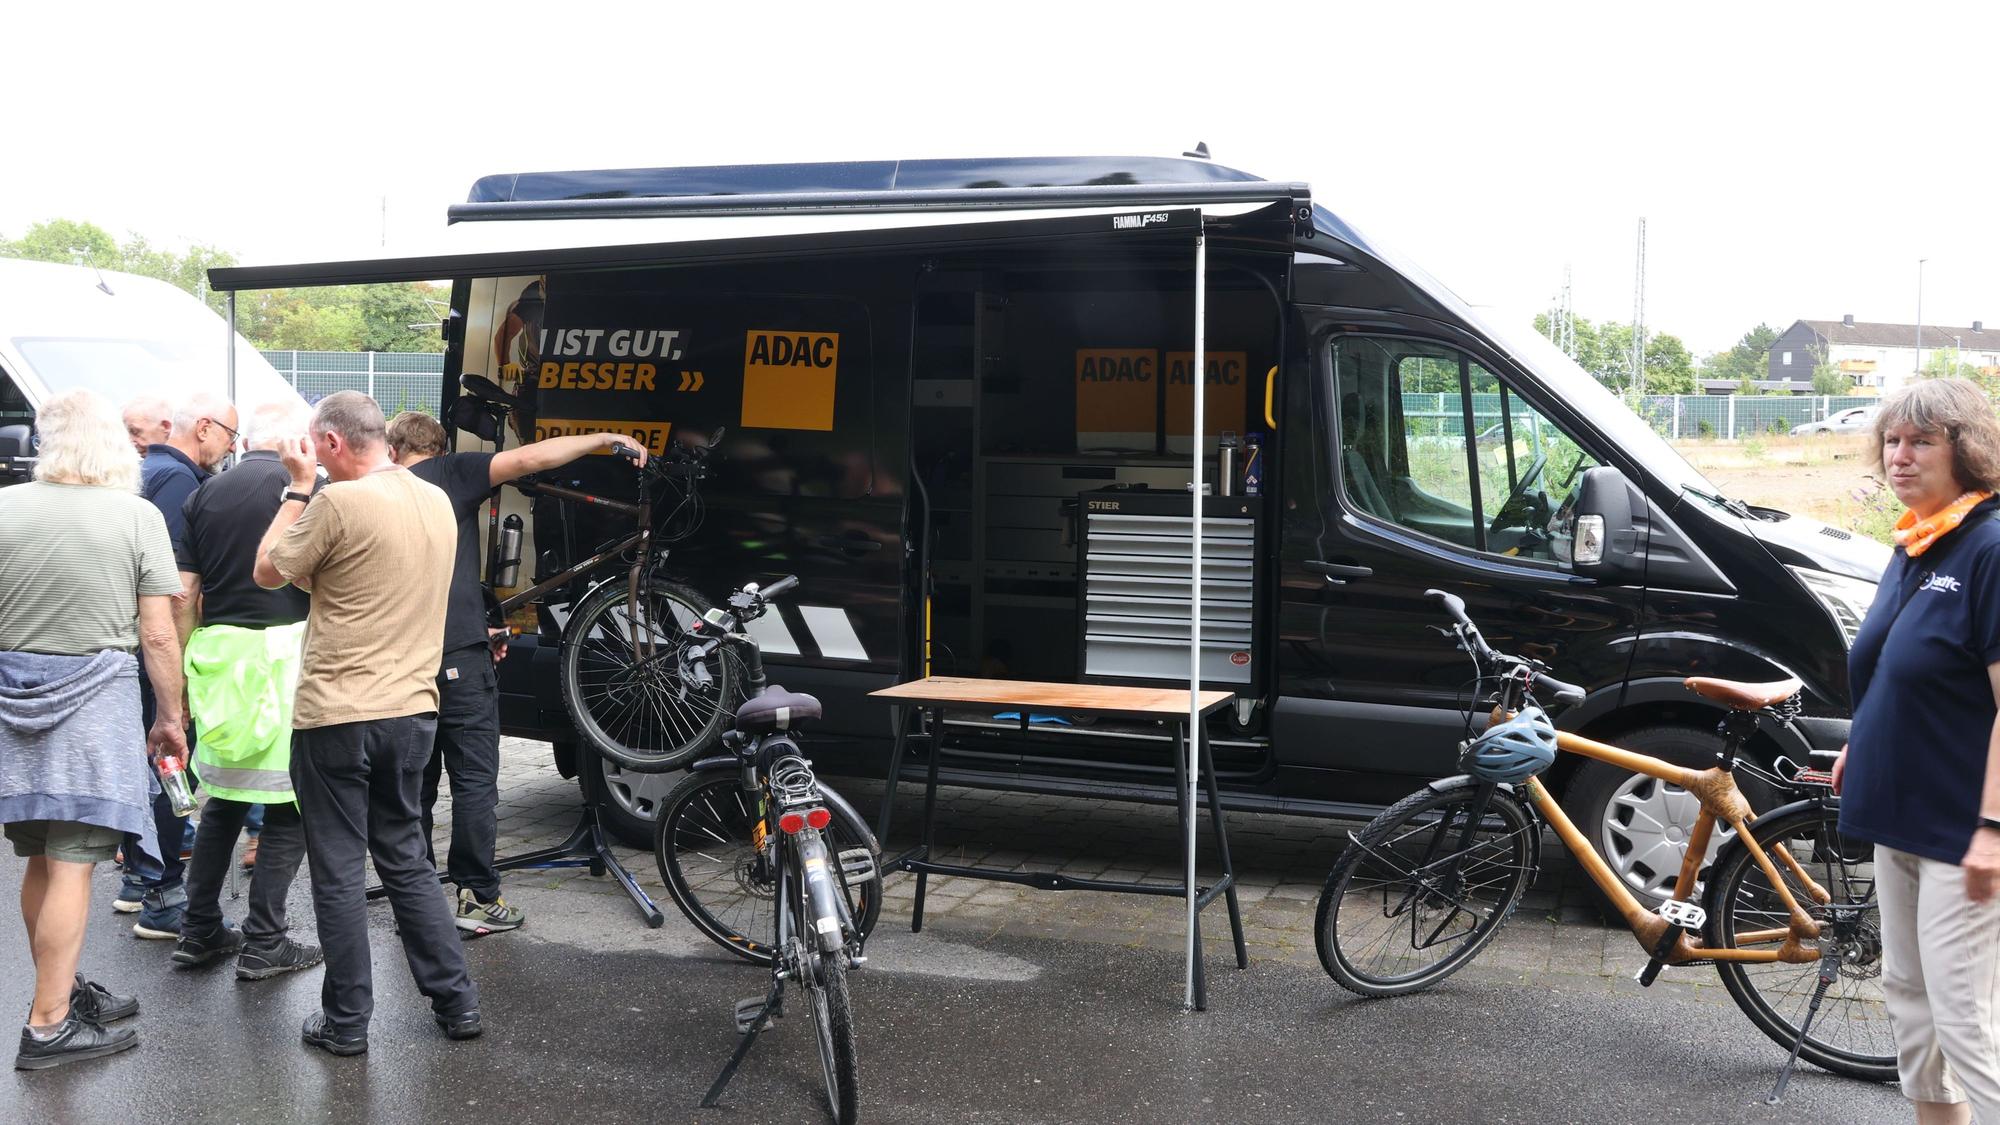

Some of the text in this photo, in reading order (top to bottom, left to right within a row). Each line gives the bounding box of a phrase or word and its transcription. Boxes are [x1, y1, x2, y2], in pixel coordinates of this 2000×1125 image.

[1113, 215, 1141, 229] FIAMMA
[553, 328, 604, 356] IST
[608, 329, 682, 361] GUT,
[750, 334, 834, 369] ADAC
[538, 361, 657, 391] BESSER
[1080, 356, 1152, 383] ADAC
[1088, 501, 1120, 511] STIER
[1934, 575, 1961, 592] adfc
